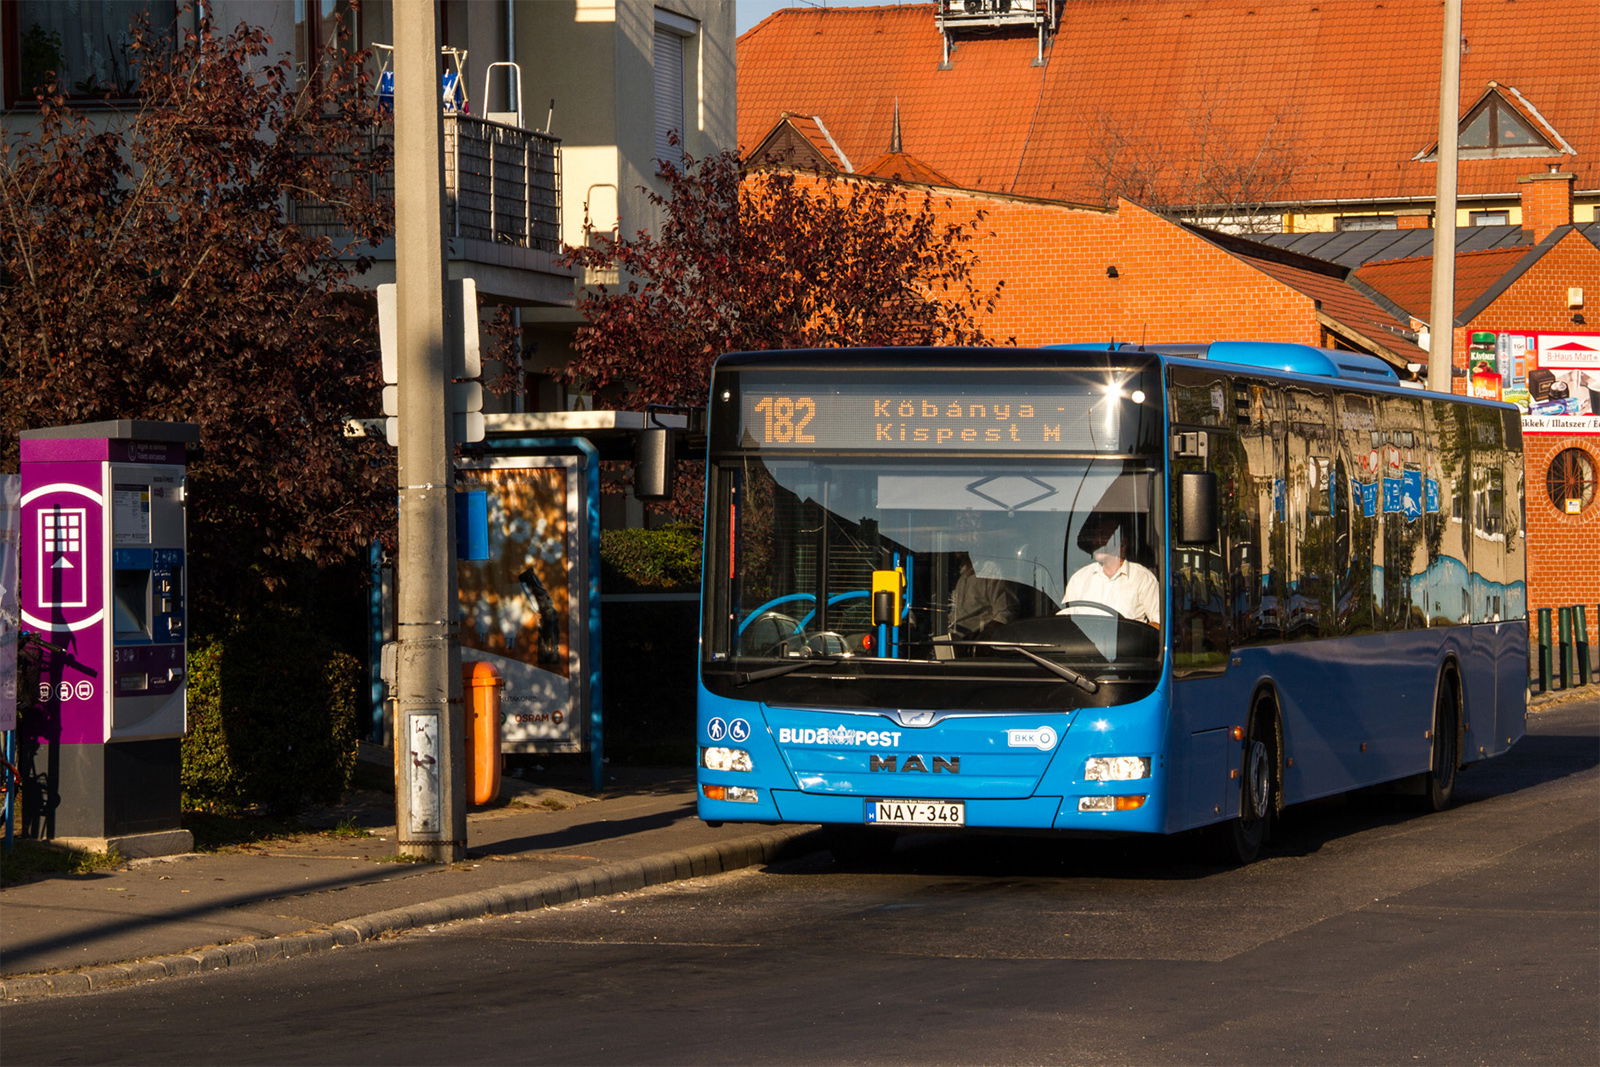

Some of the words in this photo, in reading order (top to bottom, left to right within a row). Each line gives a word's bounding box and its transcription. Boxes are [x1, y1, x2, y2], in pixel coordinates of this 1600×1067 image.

[1547, 352, 1573, 361] B-Haus
[1575, 352, 1592, 361] Mart
[754, 397, 816, 443] 182
[1521, 418, 1544, 428] ikkek
[1552, 419, 1586, 428] Illatszer
[876, 423, 1021, 444] Kispest
[1043, 424, 1061, 442] M
[515, 713, 549, 723] OSRAM
[1014, 734, 1035, 743] BKK
[869, 754, 960, 774] MAN
[879, 804, 959, 822] NAY-348
